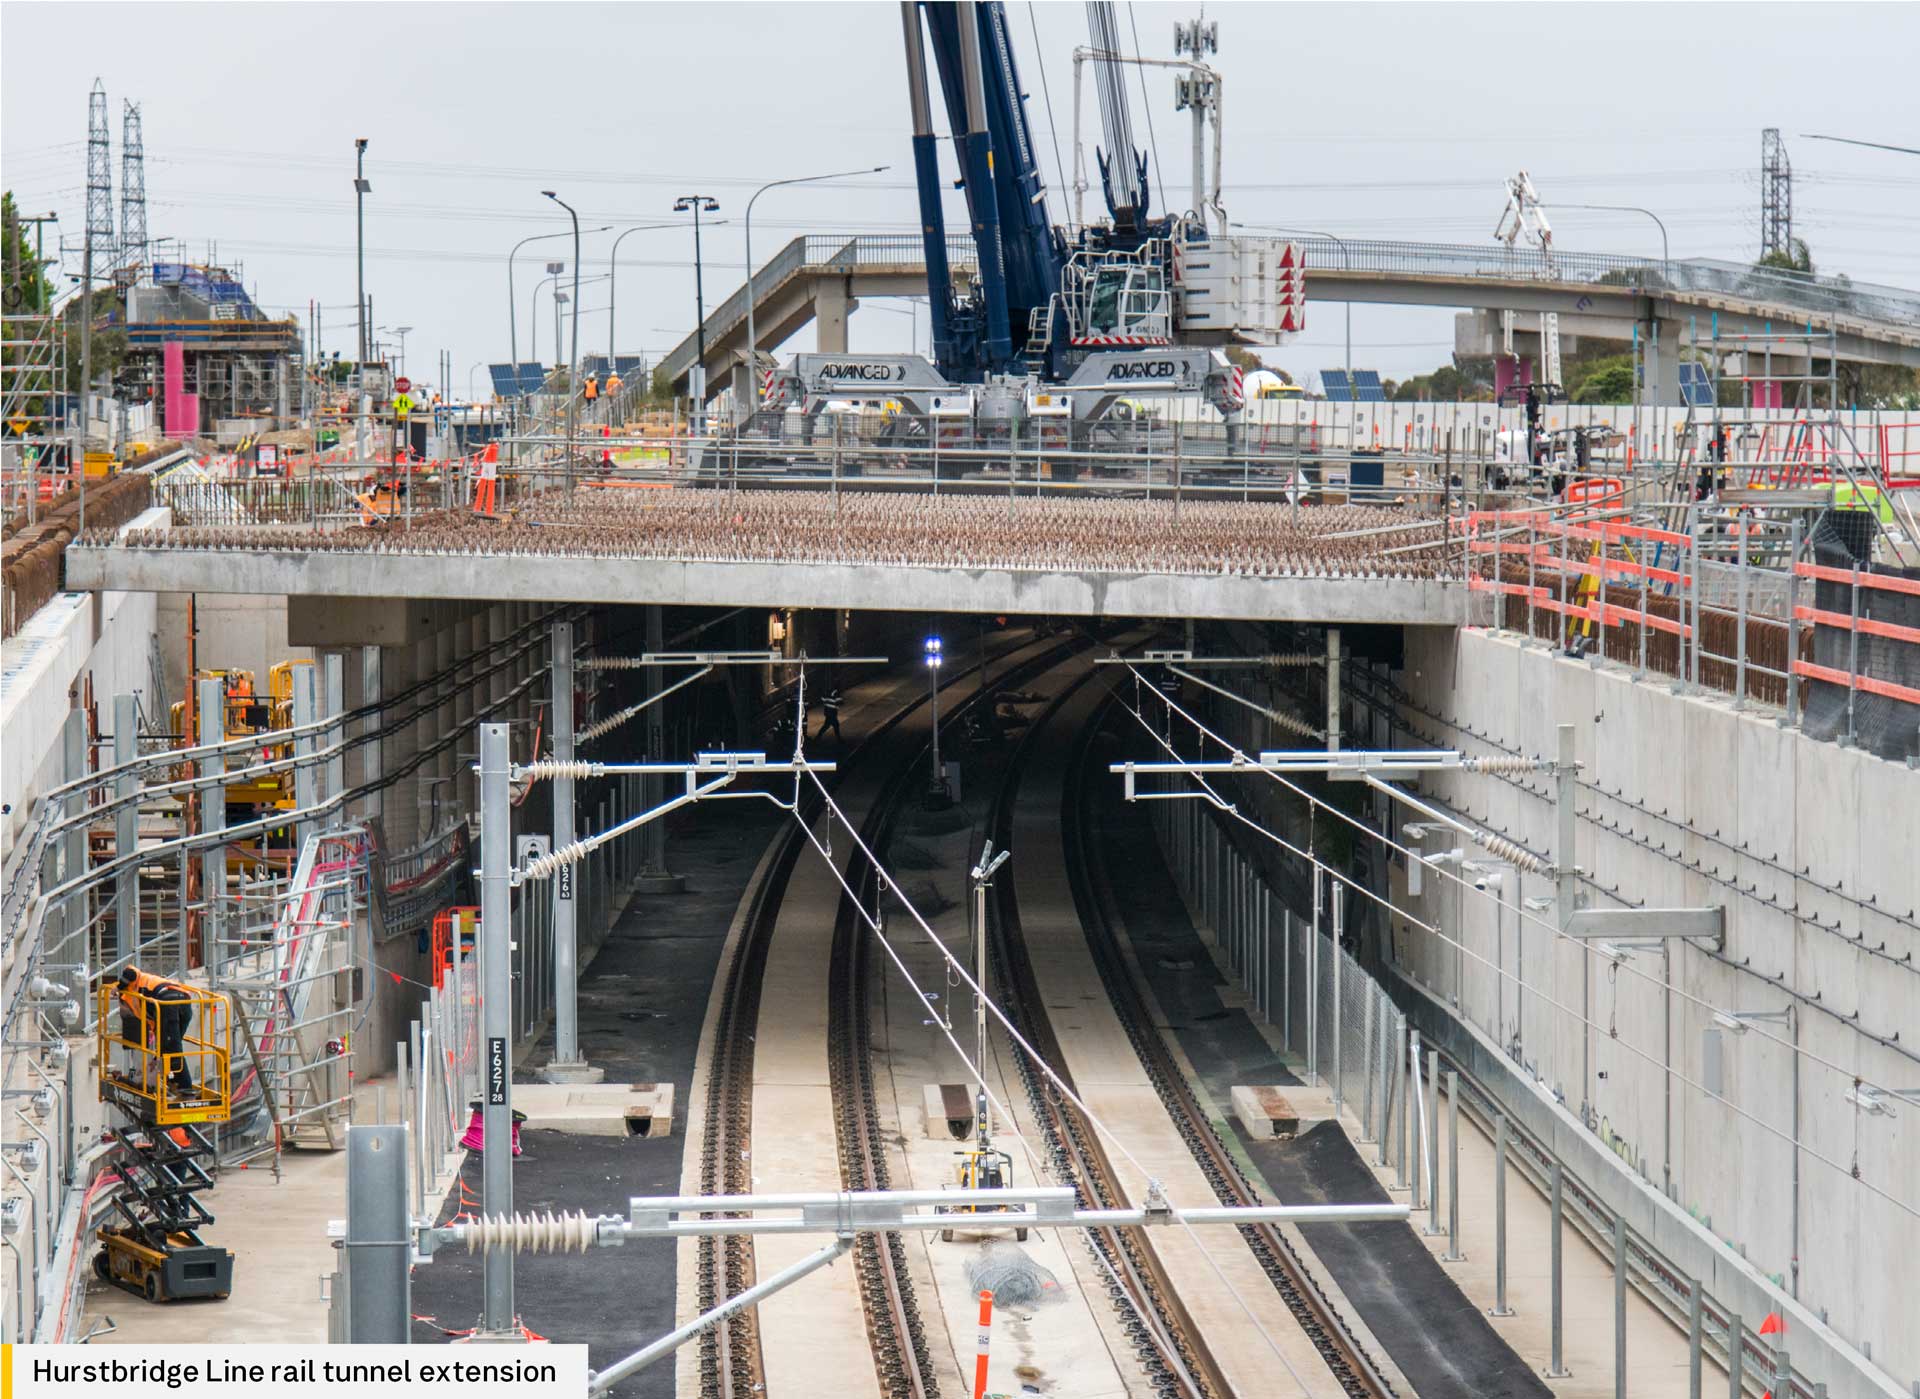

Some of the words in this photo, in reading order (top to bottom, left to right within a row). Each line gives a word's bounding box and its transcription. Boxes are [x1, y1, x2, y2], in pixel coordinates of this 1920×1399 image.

[819, 364, 891, 380] ADVANCED
[1107, 361, 1175, 380] ADVANCED
[493, 1040, 502, 1093] E627
[492, 1093, 503, 1102] 28
